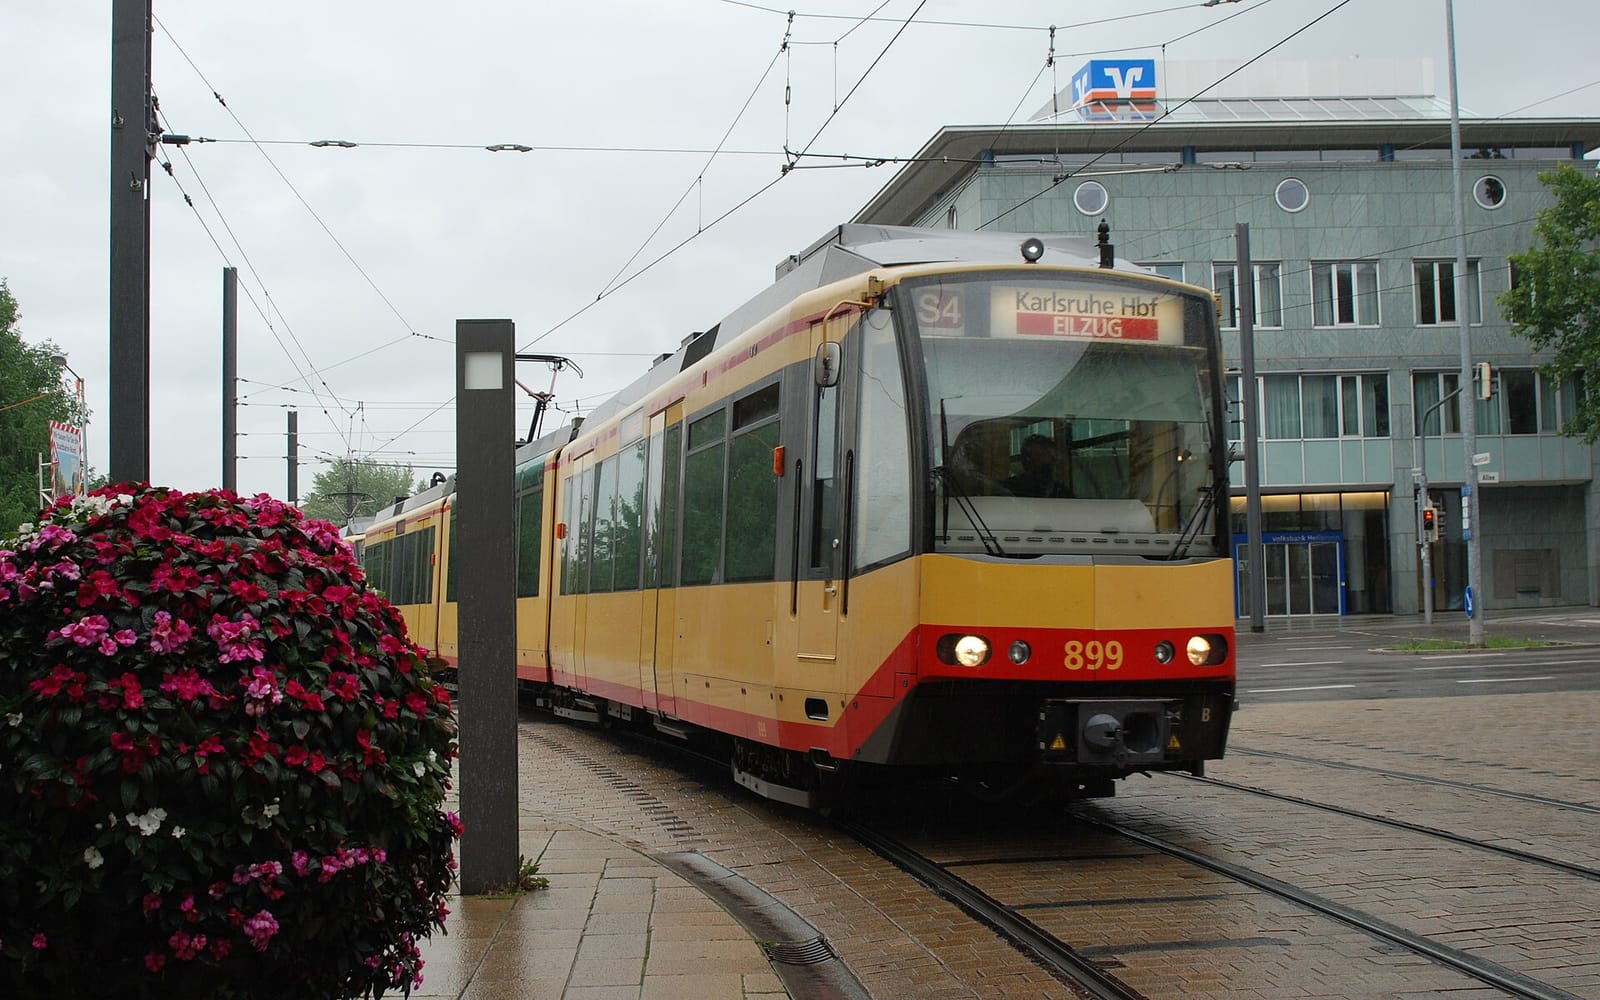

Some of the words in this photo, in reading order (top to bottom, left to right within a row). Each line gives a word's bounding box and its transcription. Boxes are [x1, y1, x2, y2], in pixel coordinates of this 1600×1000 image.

[918, 293, 961, 324] S4
[1016, 291, 1114, 315] Karlsruhe
[1121, 297, 1159, 317] Hbf
[1053, 317, 1123, 338] EILZUG
[1064, 640, 1124, 670] 899
[1202, 707, 1211, 722] B
